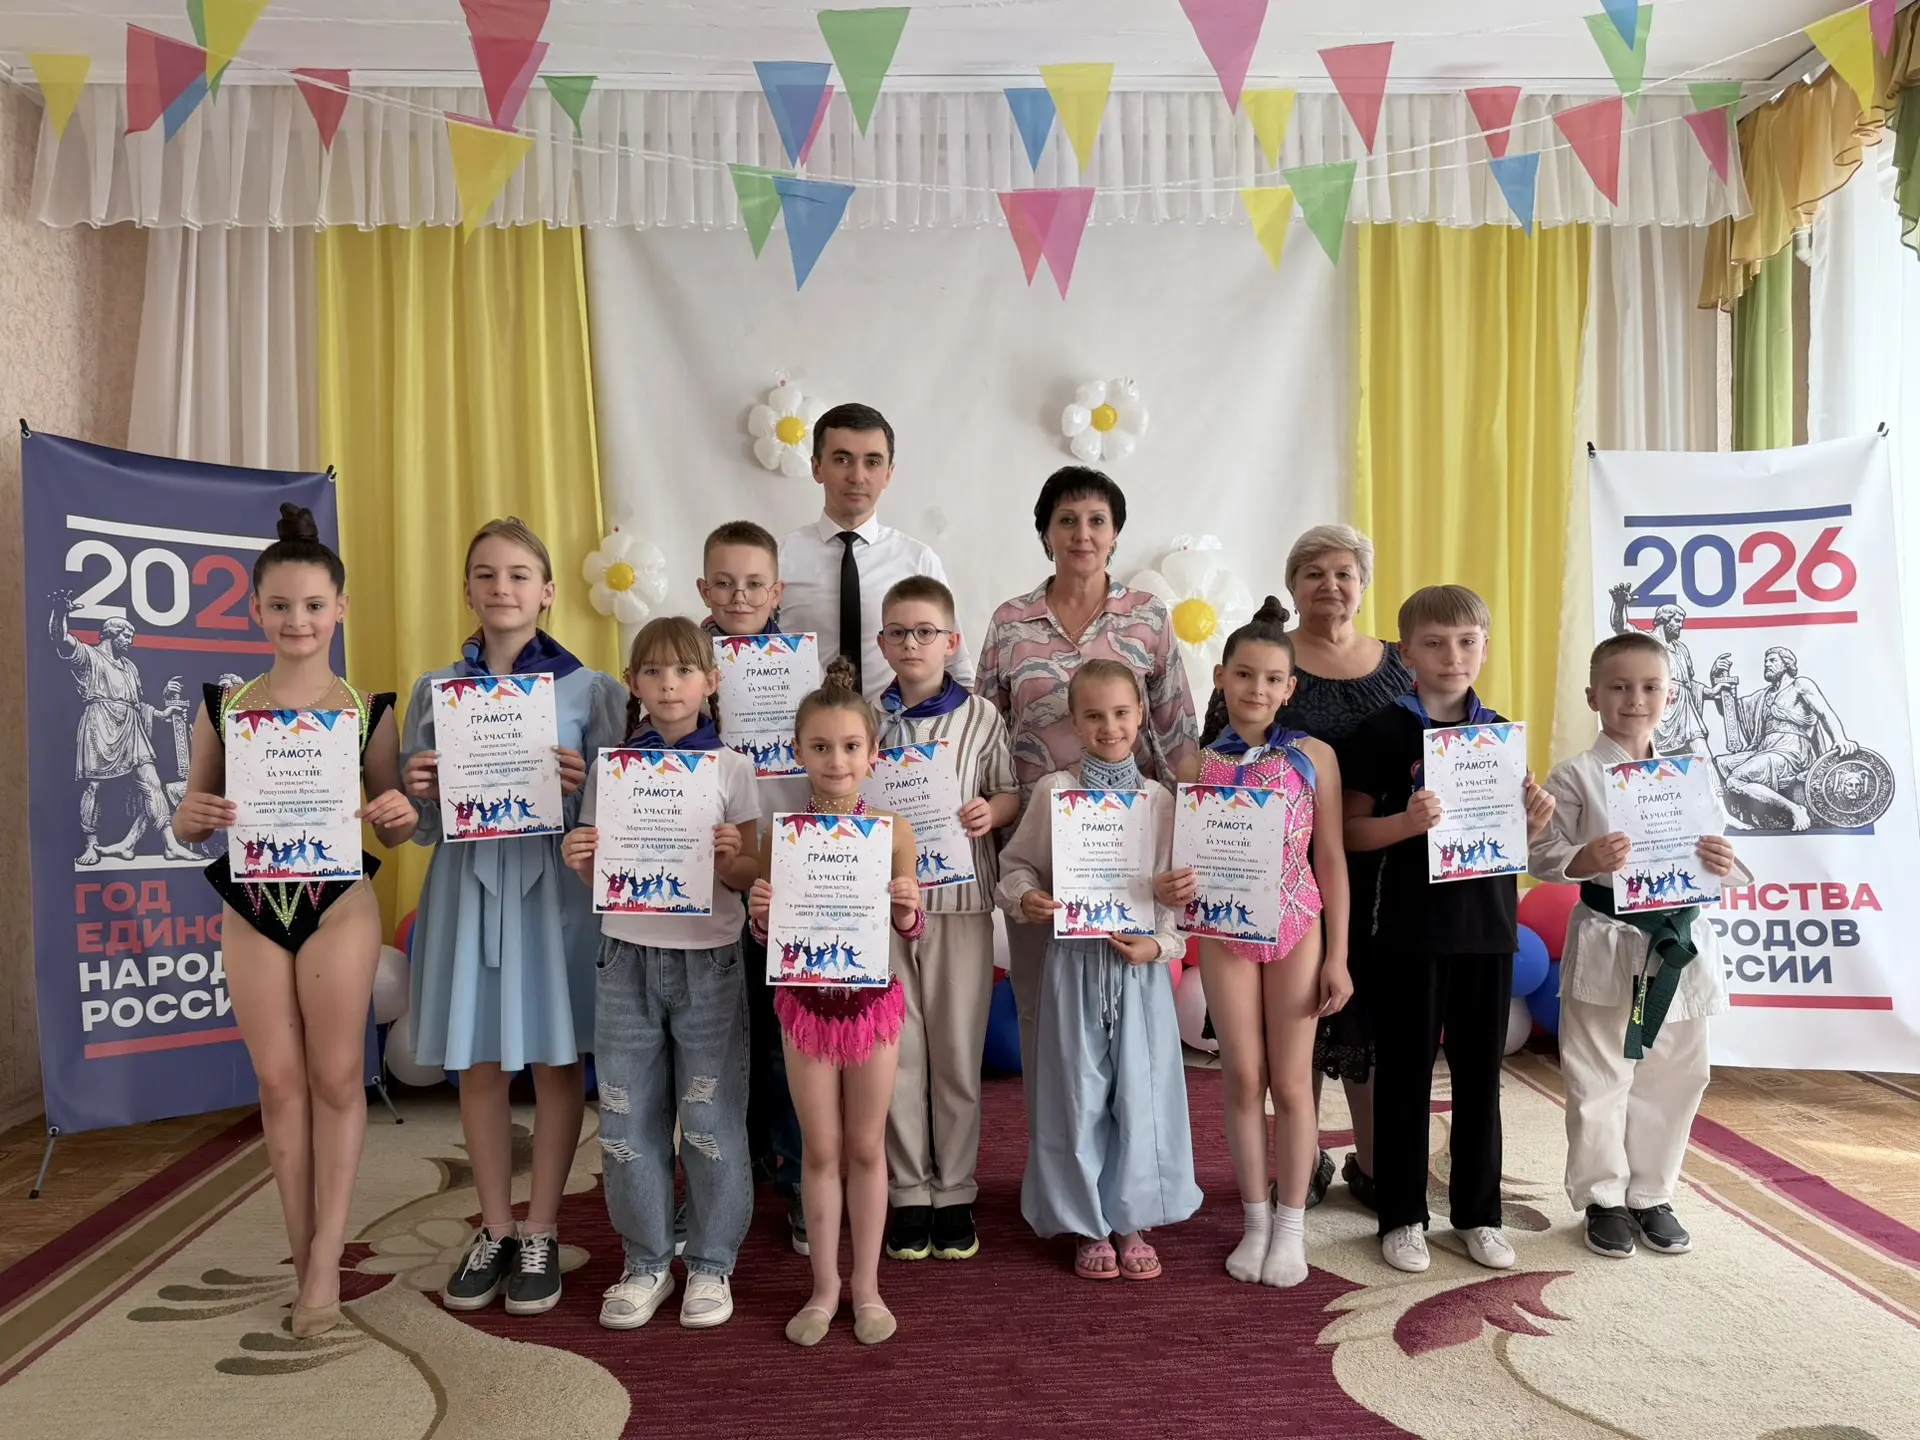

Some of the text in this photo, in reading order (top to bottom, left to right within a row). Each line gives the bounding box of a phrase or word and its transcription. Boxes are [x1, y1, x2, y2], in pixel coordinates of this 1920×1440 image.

[1624, 526, 1857, 608] 2026
[65, 540, 252, 630] 202
[746, 668, 790, 677] ГРАМОТА
[471, 713, 522, 724] ГРАМОТА
[484, 732, 523, 740] УЧАСТИЕ
[266, 749, 322, 758] ГРАМОТА
[1455, 760, 1498, 771] ГРАМОТА
[885, 777, 929, 791] ГРАМОТА
[633, 787, 683, 797] ГРАМОТА
[899, 794, 931, 804] УЧАСТИЕ
[1638, 792, 1682, 804] ГРАМОТА
[1650, 809, 1683, 819] УЧАСТИЕ
[1207, 820, 1253, 831] ГРАМОТА
[1216, 839, 1251, 847] УЧАСТИЕ
[808, 853, 858, 863] ГРАМОТА
[75, 880, 171, 915] ГОД
[1703, 883, 1883, 911] НСТВА
[77, 914, 223, 956] ЕДИНС
[1707, 918, 1861, 951] РОДОВ
